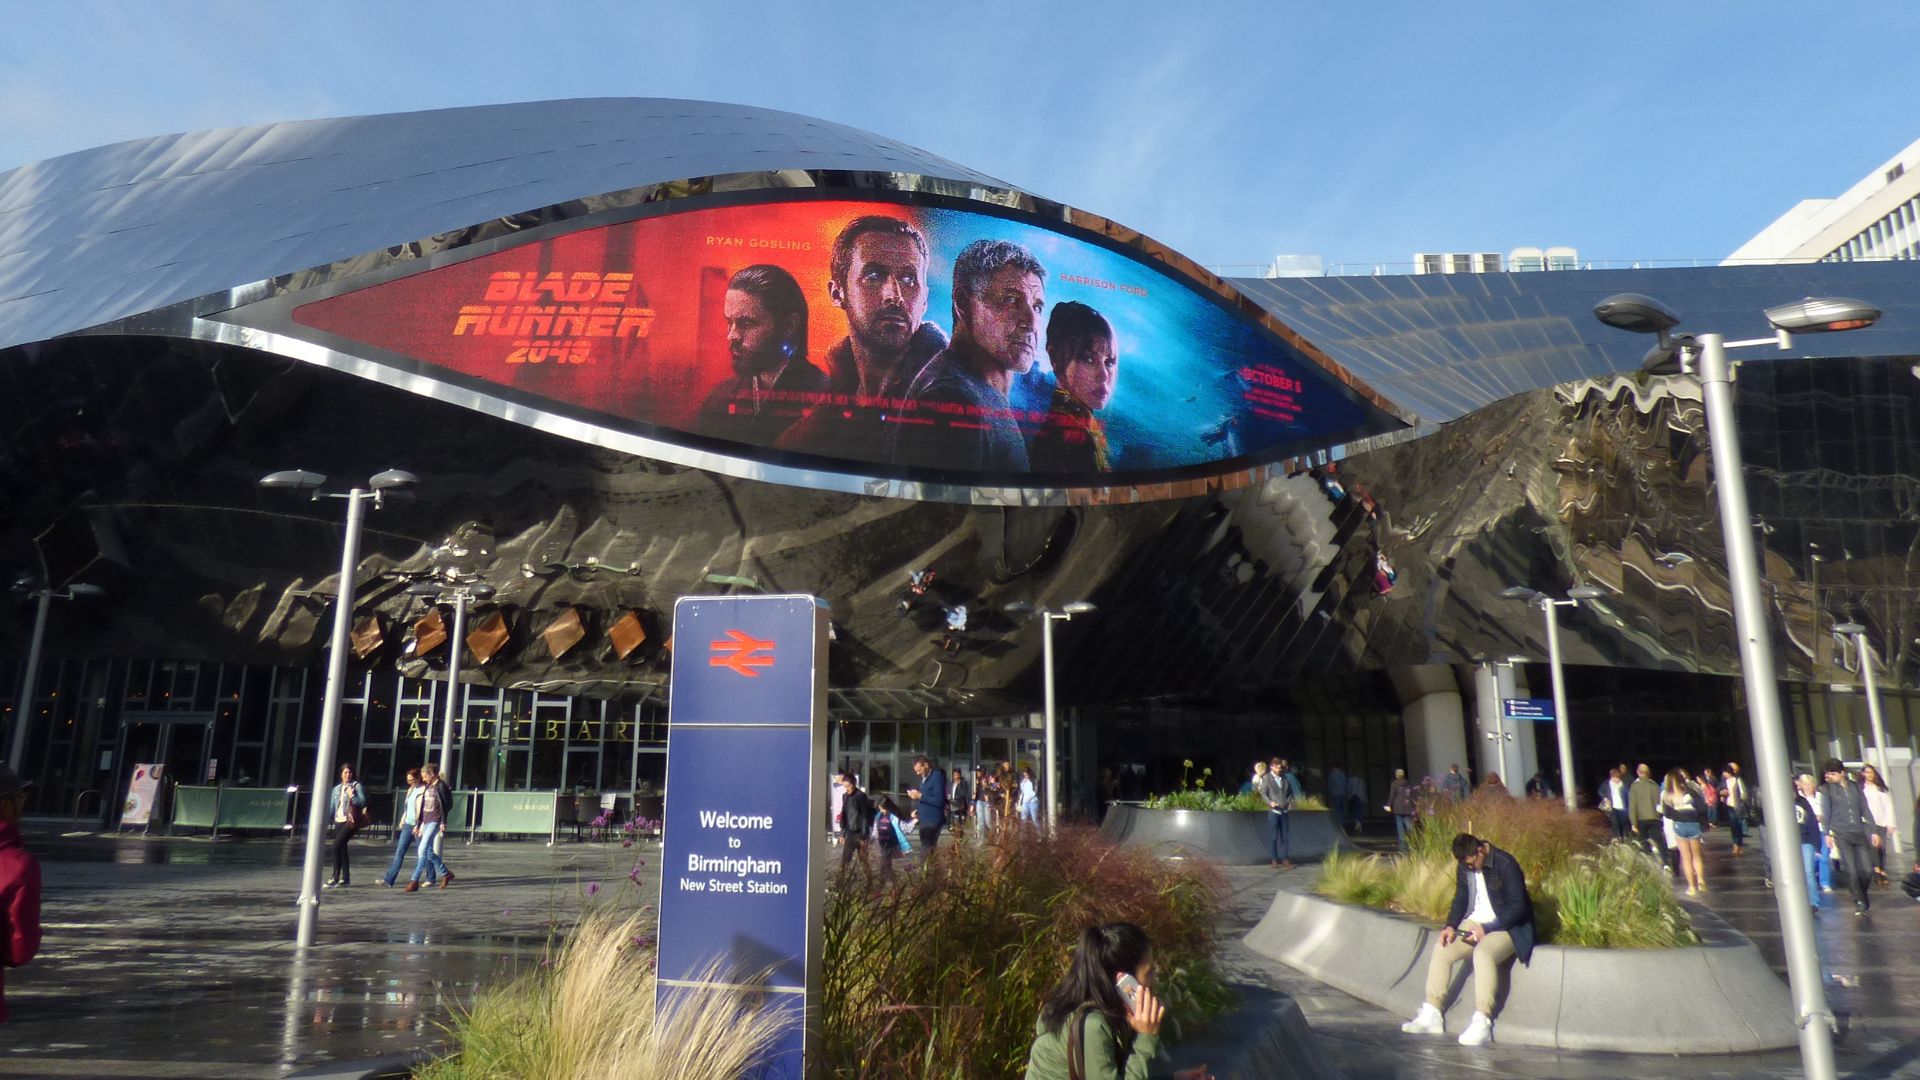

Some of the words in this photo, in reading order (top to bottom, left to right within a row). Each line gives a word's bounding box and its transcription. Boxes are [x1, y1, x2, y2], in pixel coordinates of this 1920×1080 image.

[705, 235, 744, 248] RYAN
[748, 238, 812, 252] GOSLING
[484, 271, 634, 302] BLADE
[1060, 273, 1117, 291] HARRISON
[1119, 283, 1149, 298] FORD
[452, 305, 657, 338] RUNNER
[504, 340, 592, 365] 2049
[1241, 367, 1294, 392] OCTOBER
[406, 717, 491, 740] AL
[545, 719, 628, 742] BAR
[700, 811, 773, 829] Welcome
[728, 836, 741, 848] to
[688, 854, 781, 876] Birmingham
[680, 877, 706, 892] New
[708, 878, 744, 893] Street
[746, 880, 788, 894] Station
